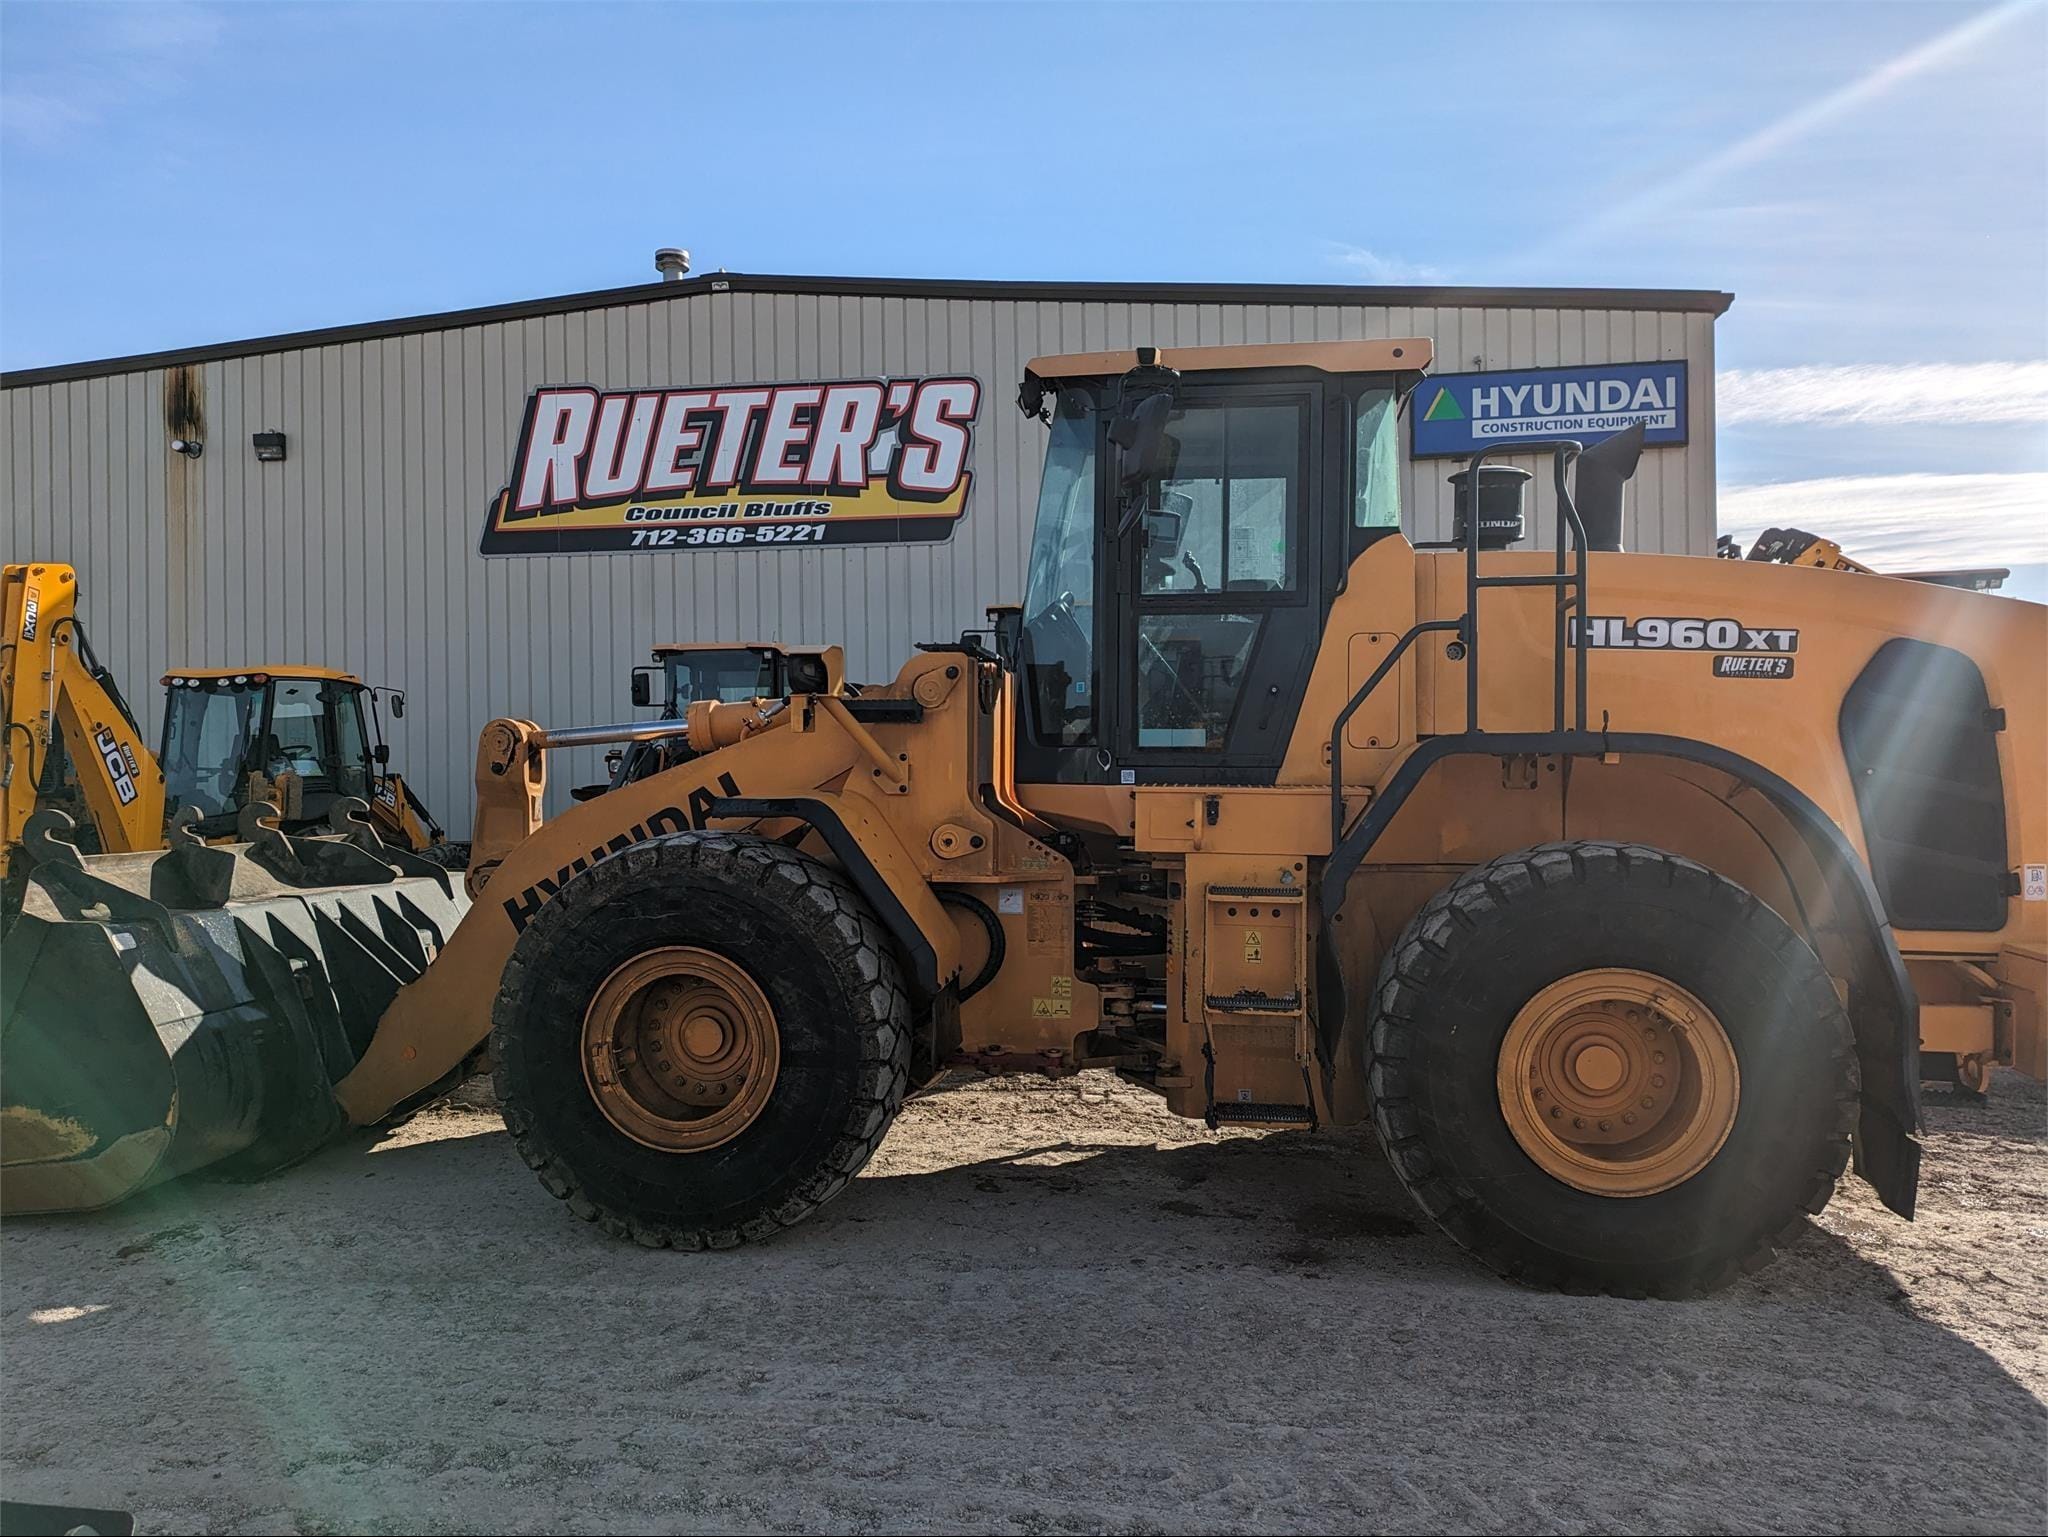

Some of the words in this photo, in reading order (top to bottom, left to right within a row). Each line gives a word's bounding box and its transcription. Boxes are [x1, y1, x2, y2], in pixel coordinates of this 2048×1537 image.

[1472, 376, 1676, 419] HYUNDAI
[1481, 419, 1583, 434] CONSTRUCTION
[1587, 414, 1667, 429] EQUIPMENT
[514, 380, 979, 512] RUETER'S
[625, 503, 739, 521] Council
[743, 501, 831, 518] Bluffs
[631, 524, 826, 546] 712-366-5221
[1720, 656, 1788, 674] RUETER'S
[97, 733, 136, 804] JCB
